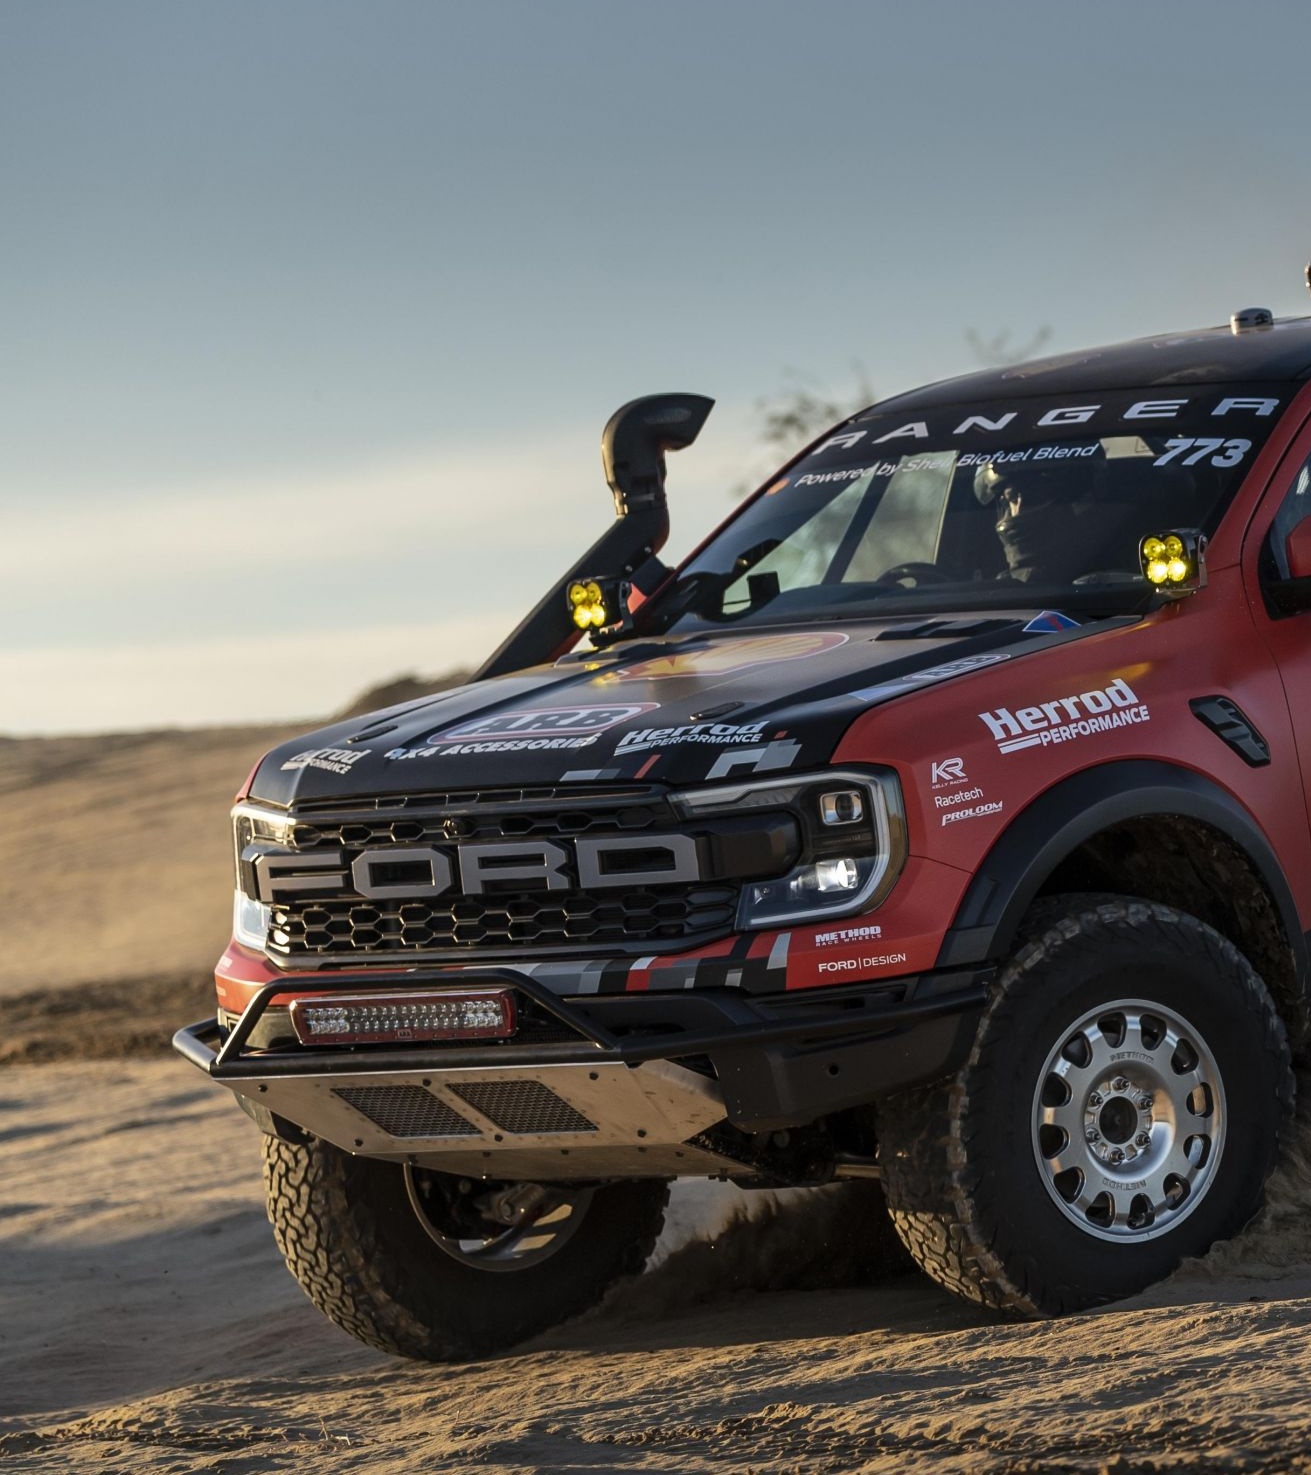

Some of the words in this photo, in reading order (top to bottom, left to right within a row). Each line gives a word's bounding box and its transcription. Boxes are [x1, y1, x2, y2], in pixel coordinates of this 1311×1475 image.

[813, 397, 1280, 455] RANGER
[793, 461, 879, 489] Powered
[876, 461, 903, 477] by
[956, 447, 1032, 467] Biofuel
[1033, 441, 1100, 461] Blend
[1152, 437, 1253, 469] 773
[452, 709, 623, 736] ARB
[978, 678, 1140, 741] Herrod
[616, 720, 771, 748] Herrod
[1040, 705, 1150, 747] PERFORMANCE
[439, 733, 604, 757] ACCESSORIES
[650, 733, 764, 749] PERFORMANCE
[931, 757, 968, 784] KR
[934, 787, 984, 808] Racetech
[942, 800, 1003, 827] PROLOOM
[248, 834, 700, 901] FORD
[815, 925, 882, 943] METHOD
[815, 940, 840, 948] RACE
[843, 934, 882, 943] WHEELS
[818, 959, 857, 973] FORD
[863, 953, 907, 967] DESIGN
